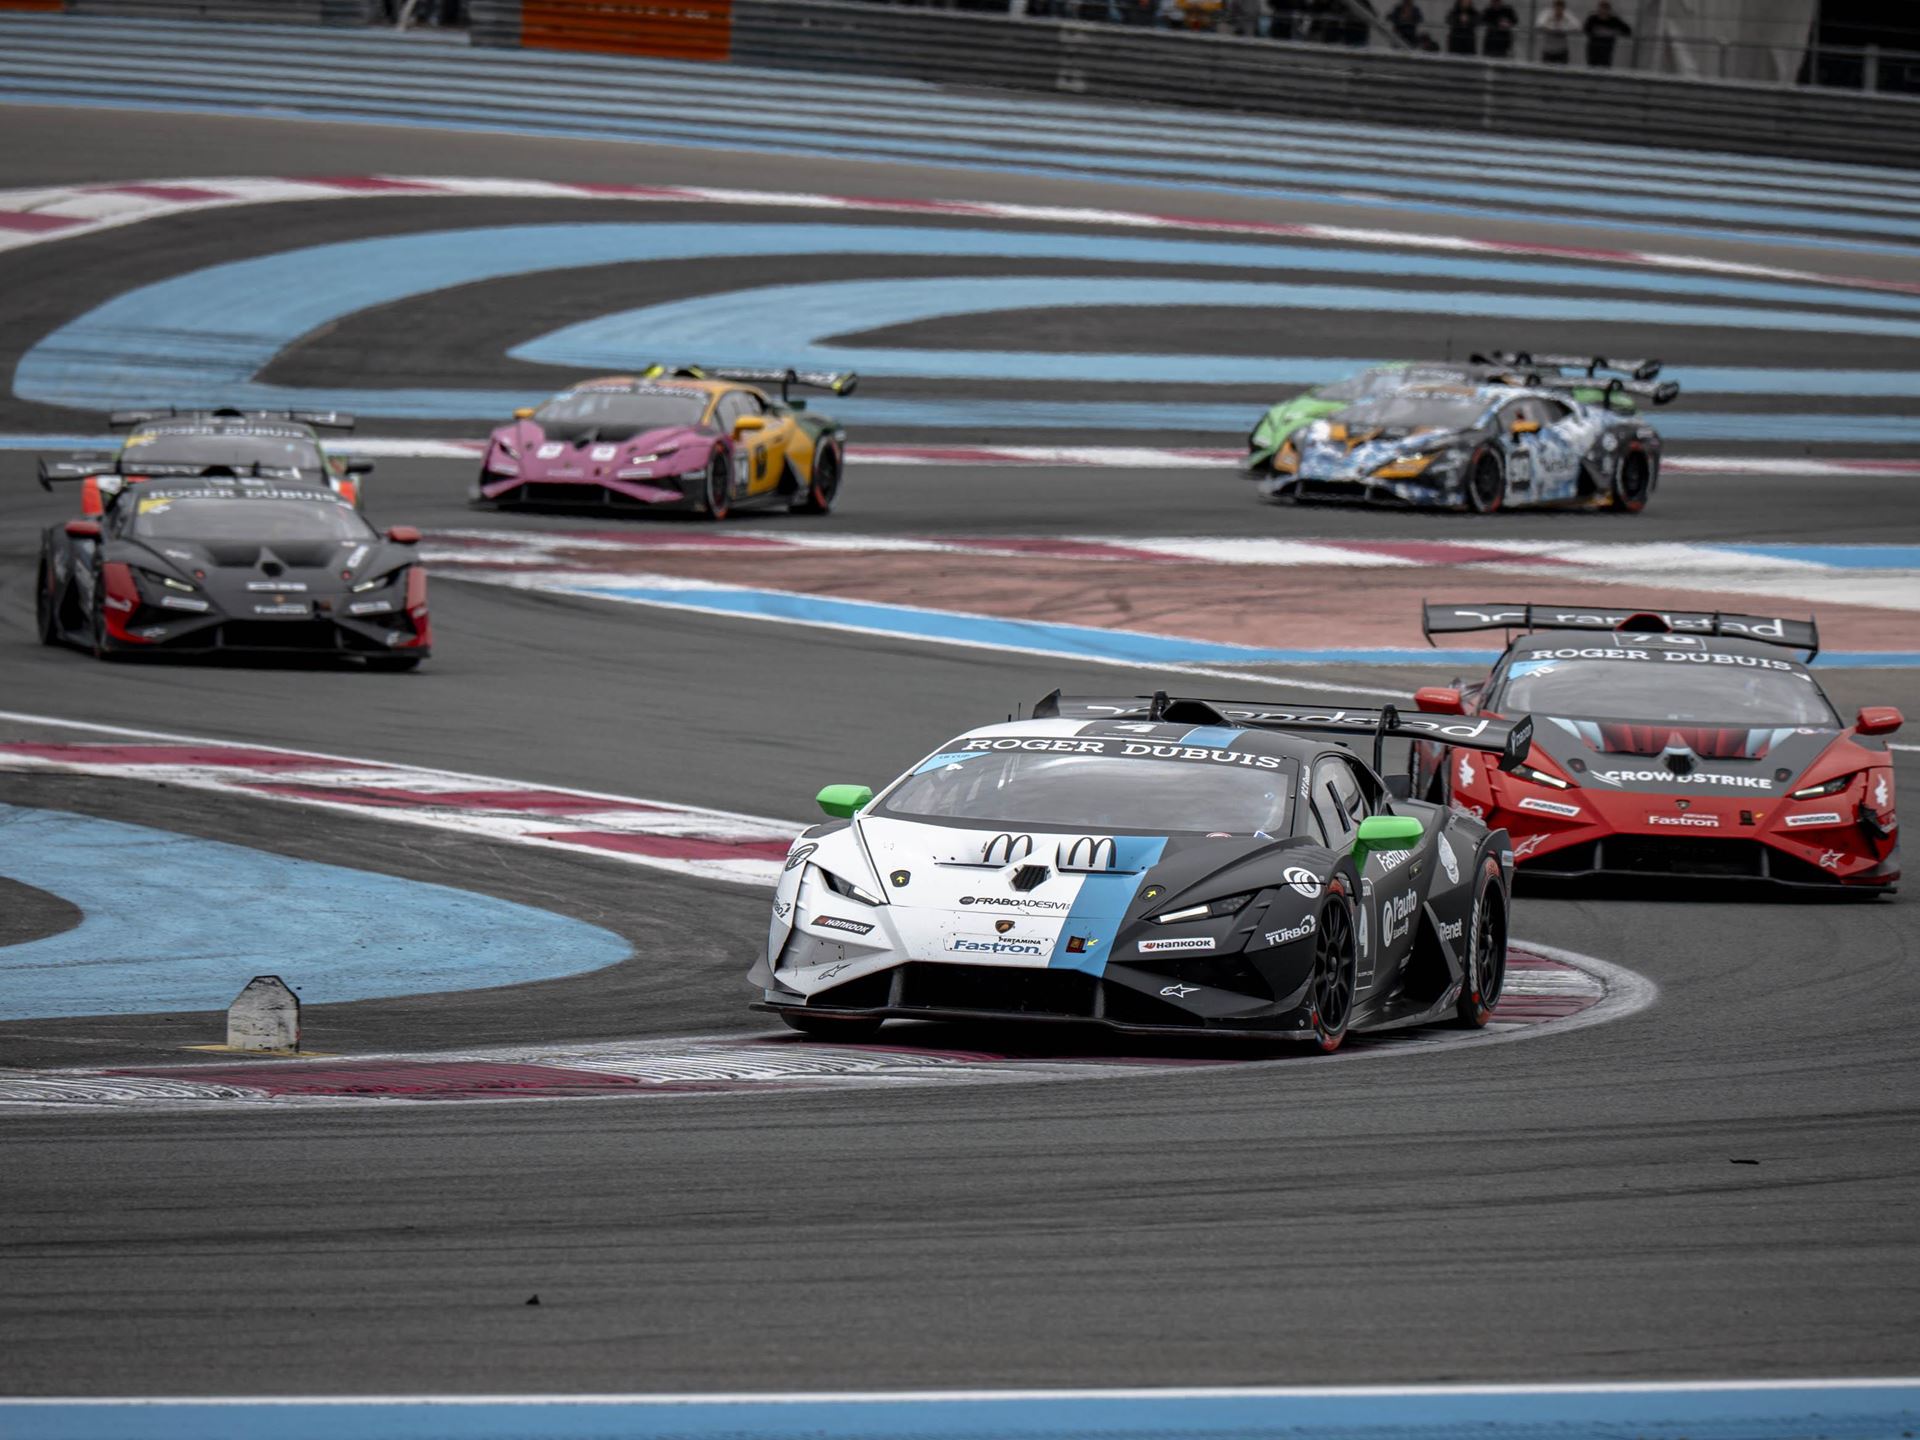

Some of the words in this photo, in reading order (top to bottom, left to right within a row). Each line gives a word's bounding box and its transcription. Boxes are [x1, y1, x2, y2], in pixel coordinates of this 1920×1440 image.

[1556, 614, 1785, 638] ranstad
[1531, 649, 1650, 660] ROGER
[1664, 651, 1792, 671] DUBUIS
[962, 739, 1104, 753] ROGER
[1120, 743, 1281, 769] DUBUIS
[1605, 770, 1773, 789] CROWDSTRIKE
[1649, 815, 1719, 828] Fastron
[975, 897, 1066, 911] FRABOADESIVI
[999, 936, 1042, 945] PERTAMINA
[1266, 925, 1310, 945] TURBO
[953, 939, 1040, 954] Fastron
